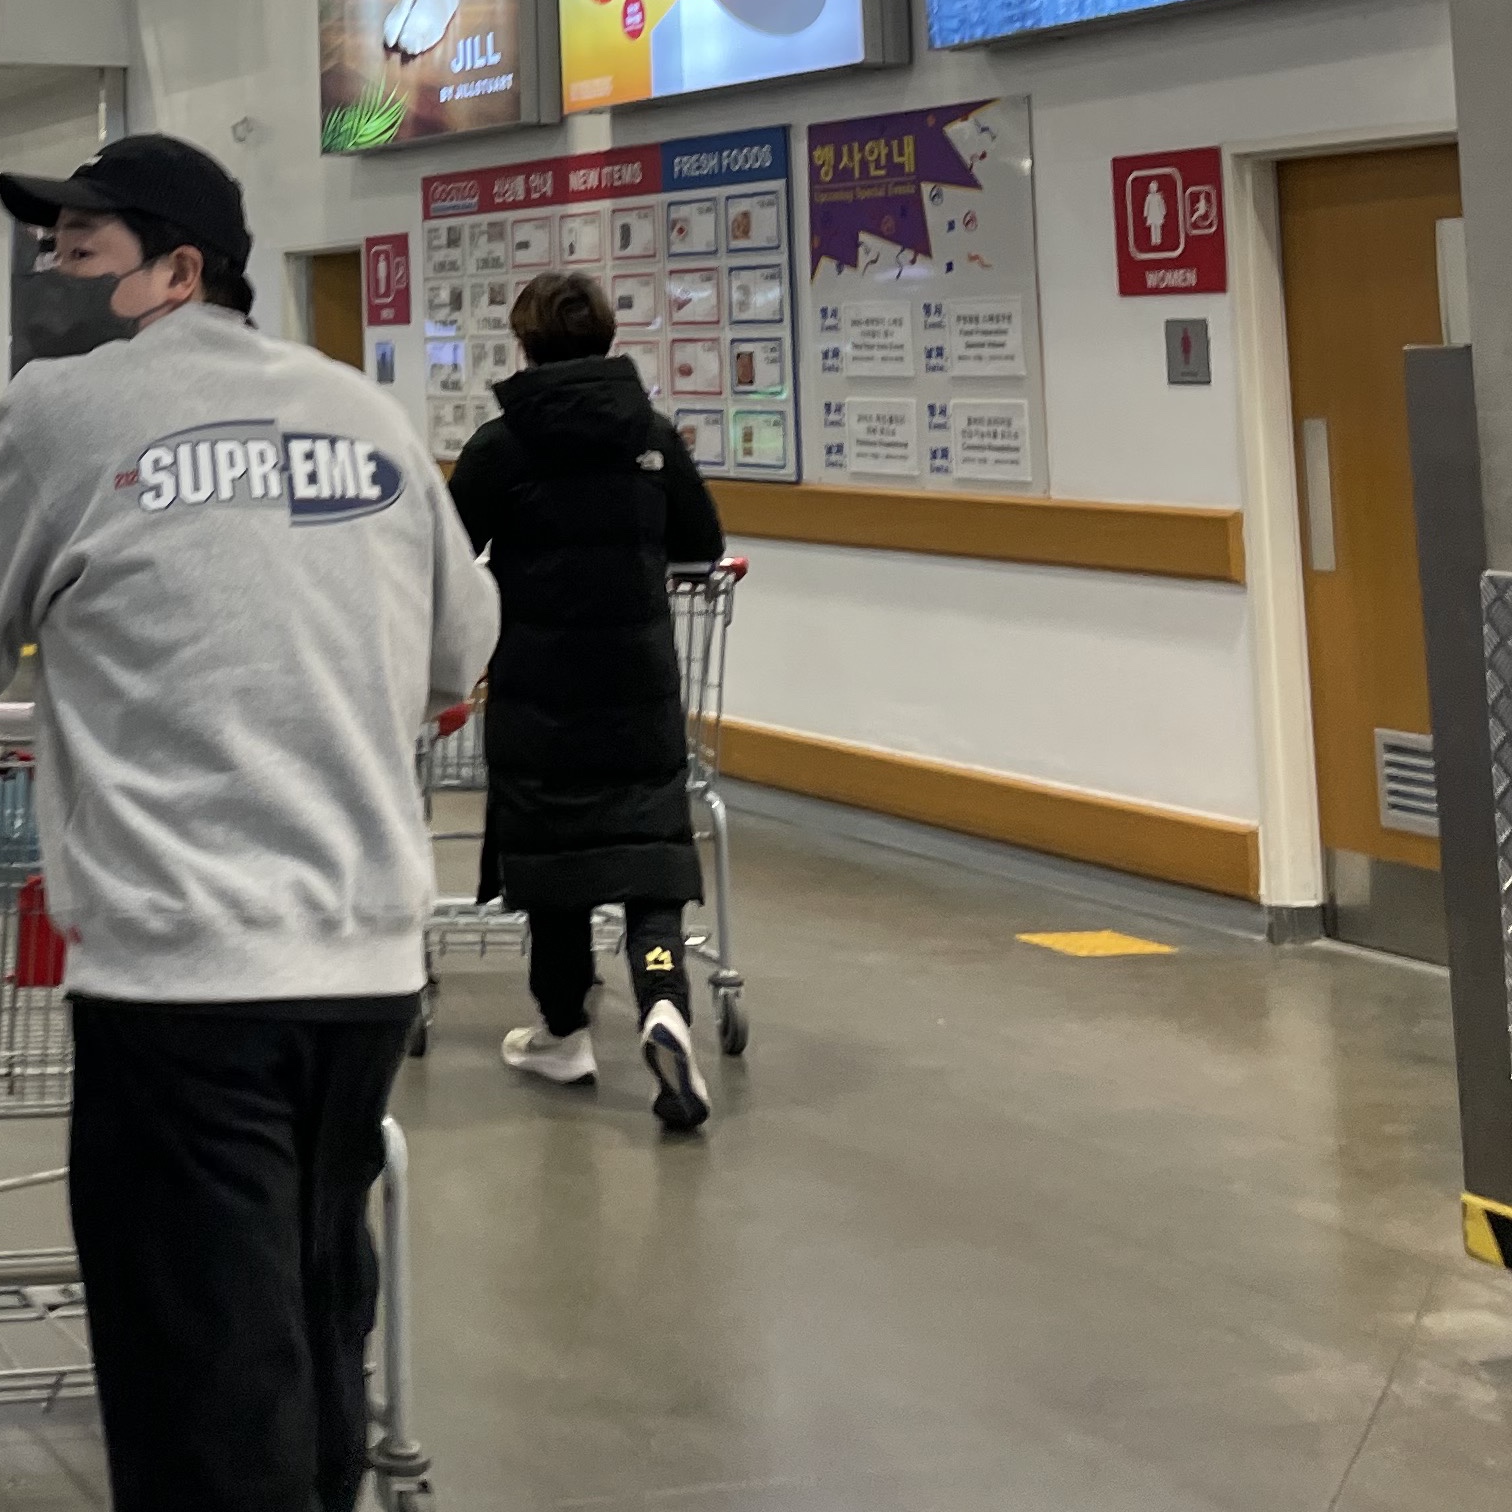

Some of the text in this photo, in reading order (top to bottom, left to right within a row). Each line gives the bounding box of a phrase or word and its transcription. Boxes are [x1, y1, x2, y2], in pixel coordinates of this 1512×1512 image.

[450, 31, 502, 74] JILL
[439, 84, 454, 103] BY
[568, 160, 643, 193] NEW ITEMS
[673, 144, 773, 180] FRESH FOODS
[813, 135, 916, 182] 행사안내
[1145, 268, 1197, 289] WOMEN
[138, 437, 383, 512] SUPREME
